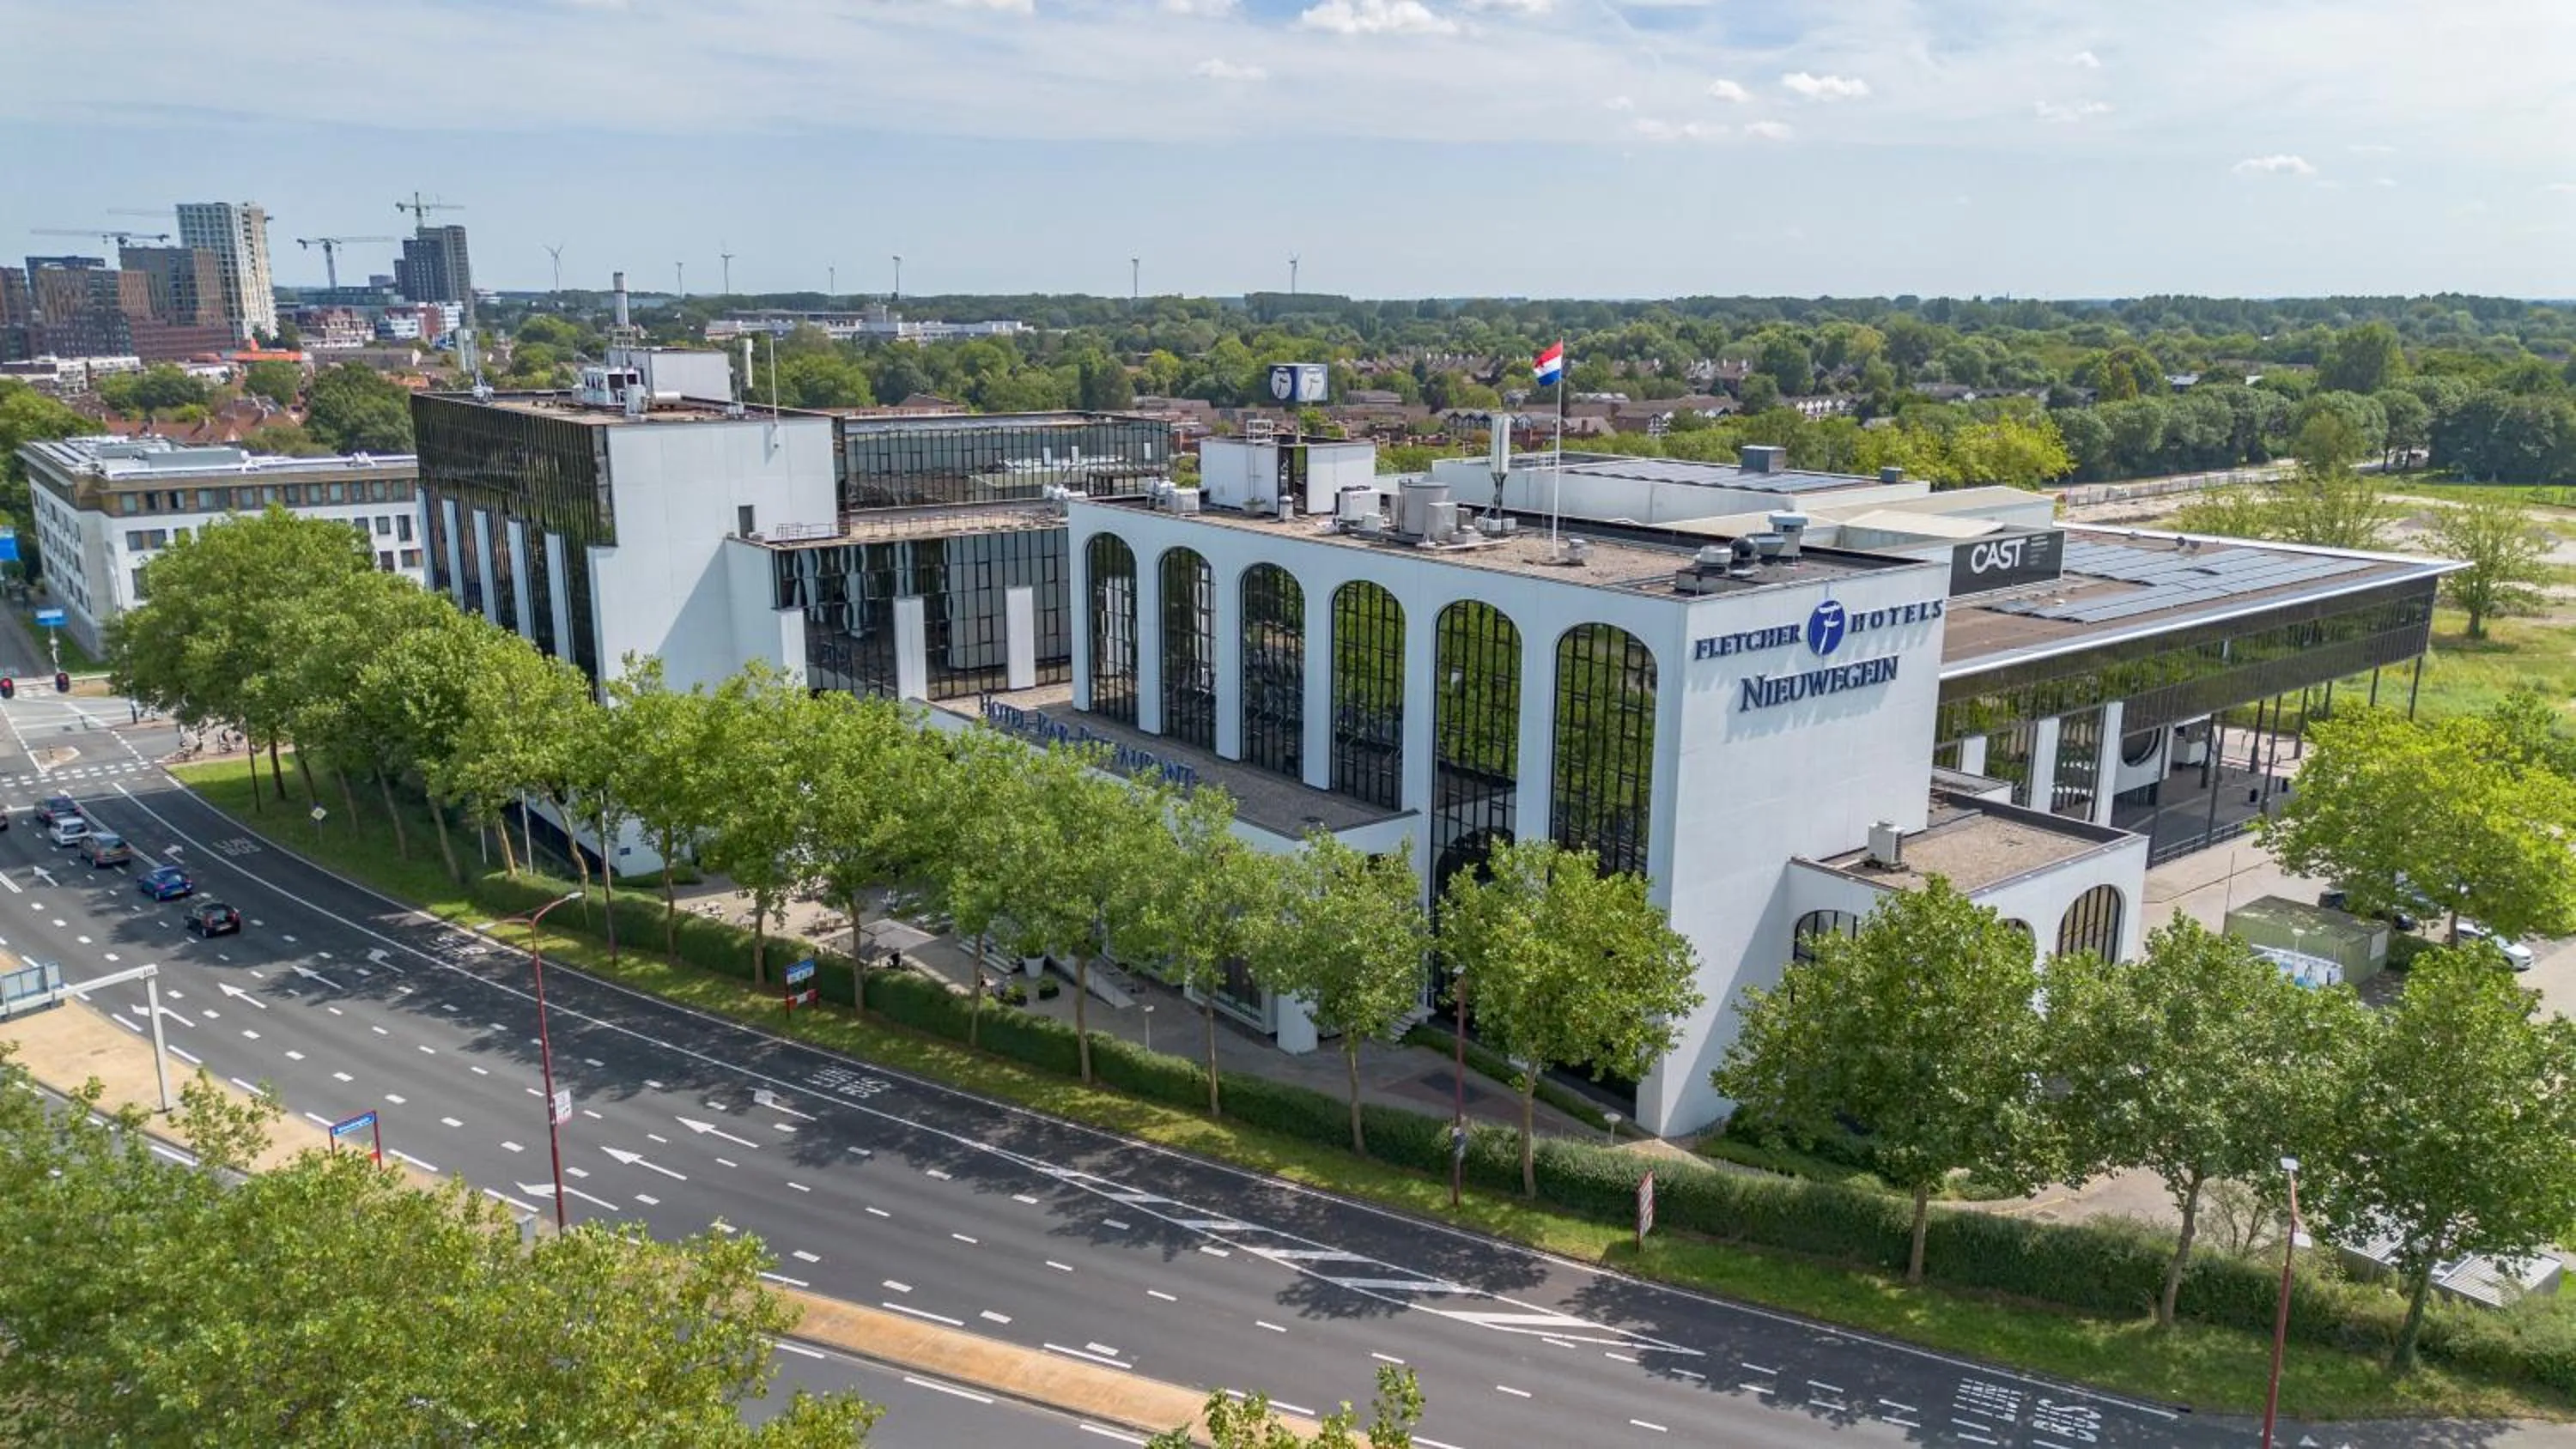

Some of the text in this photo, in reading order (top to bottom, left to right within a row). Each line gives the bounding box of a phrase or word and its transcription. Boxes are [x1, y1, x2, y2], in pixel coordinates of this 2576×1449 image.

[1971, 537, 2027, 574] CAST
[1693, 623, 1801, 660] FLETCHER
[1850, 599, 1943, 634] HOTELS
[1739, 654, 1899, 712] NIEUWEGEIN
[2032, 1398, 2103, 1443] BUS
